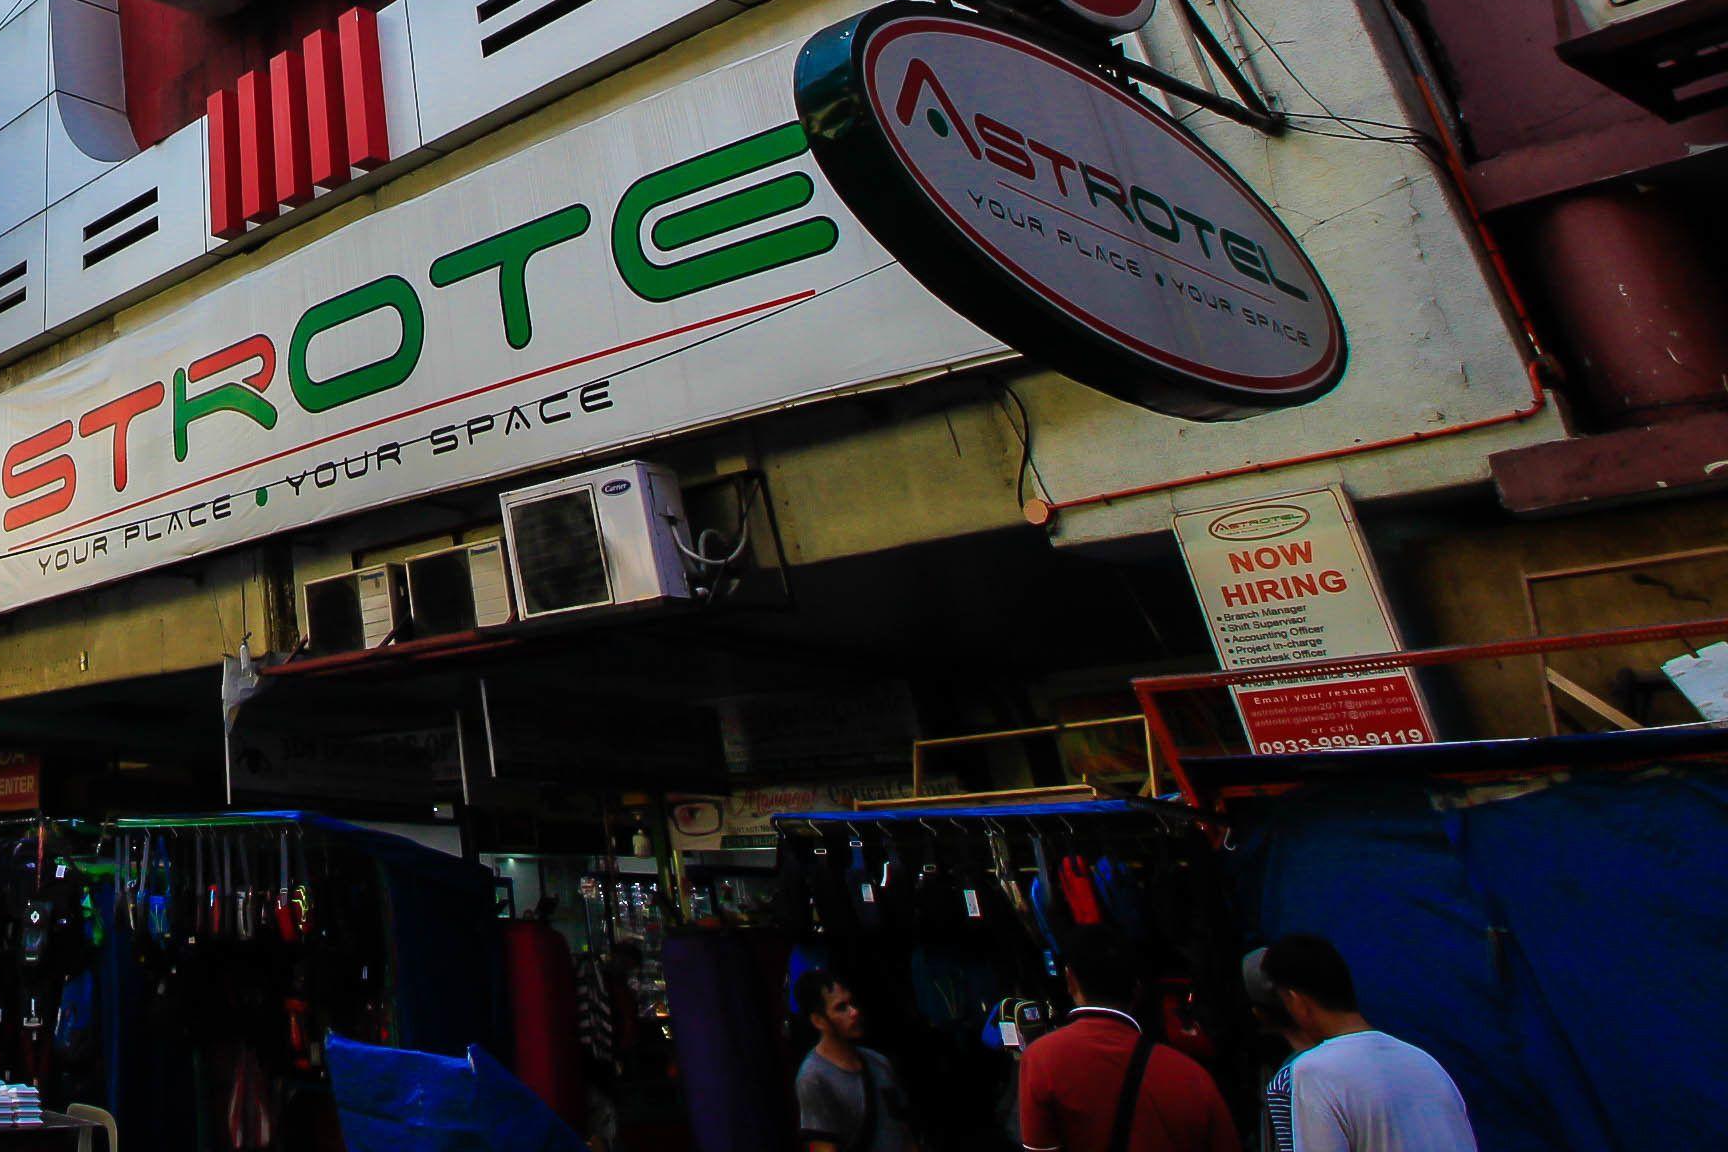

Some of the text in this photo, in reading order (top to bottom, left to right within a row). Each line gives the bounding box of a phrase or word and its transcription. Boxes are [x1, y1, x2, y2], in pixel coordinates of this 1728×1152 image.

[896, 58, 1309, 302] ASTROTEL
[967, 189, 1311, 348] YOUR PLACE YOUR SPACE
[38, 380, 614, 575] YOUR PLACE YOUR SPACE
[1215, 513, 1303, 533] ASTROTEL
[1228, 541, 1312, 574] NOW
[1221, 570, 1347, 608] HIRING
[1224, 605, 1307, 622] Branch Manager
[1228, 616, 1307, 632] Shift Supervisor
[1232, 625, 1324, 644] Accounting Officer
[1236, 643, 1271, 655] Project
[1240, 649, 1327, 665] Frontdesk Officer
[1253, 683, 1396, 705] Email your resume at
[1311, 724, 1355, 735] or call
